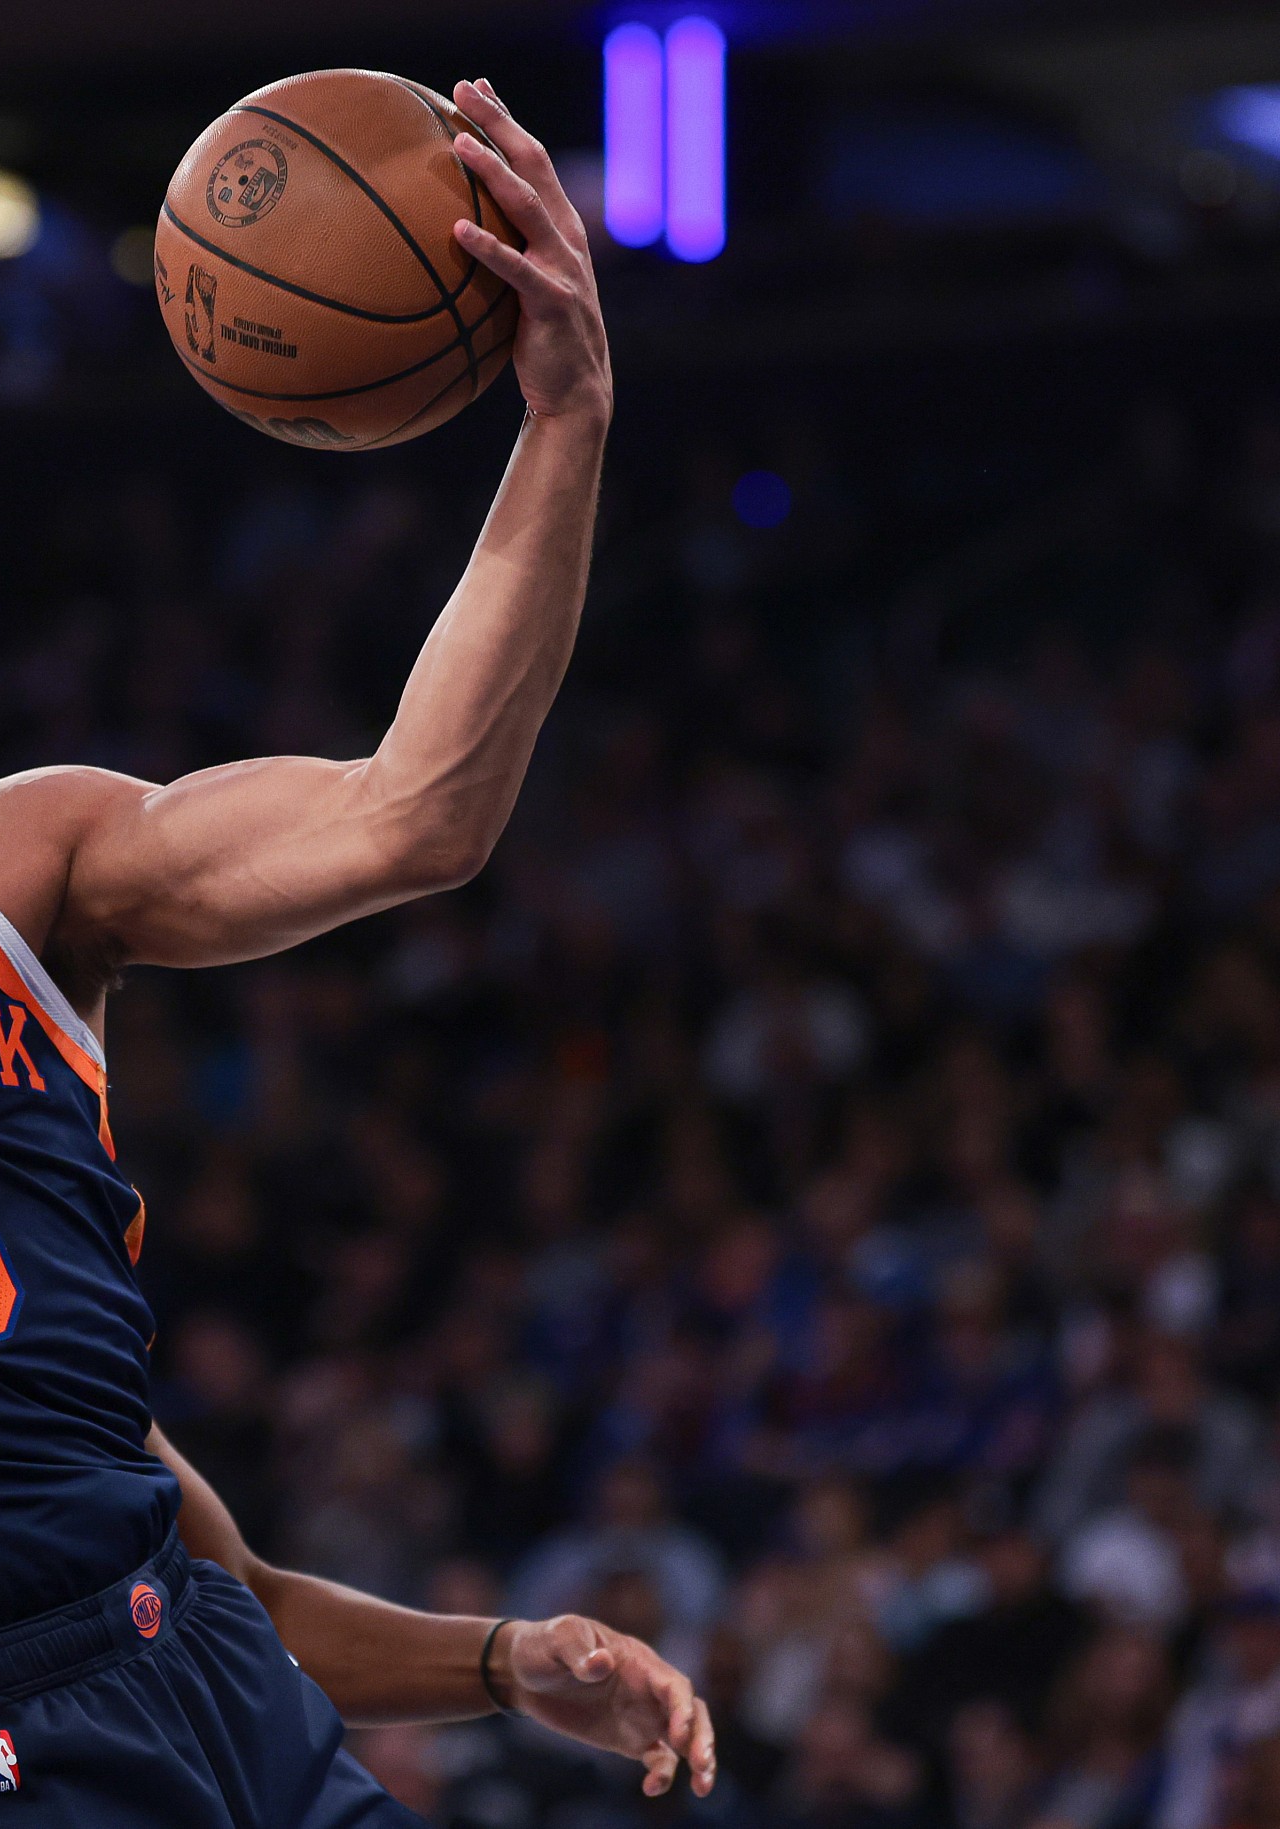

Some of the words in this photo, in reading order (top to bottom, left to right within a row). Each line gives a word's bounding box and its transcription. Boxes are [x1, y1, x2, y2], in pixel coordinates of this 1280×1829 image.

[221, 324, 237, 342] BALL
[239, 331, 260, 350] GAME
[261, 340, 298, 359] OFFICIAL
[134, 1596, 160, 1626] KNICKS
